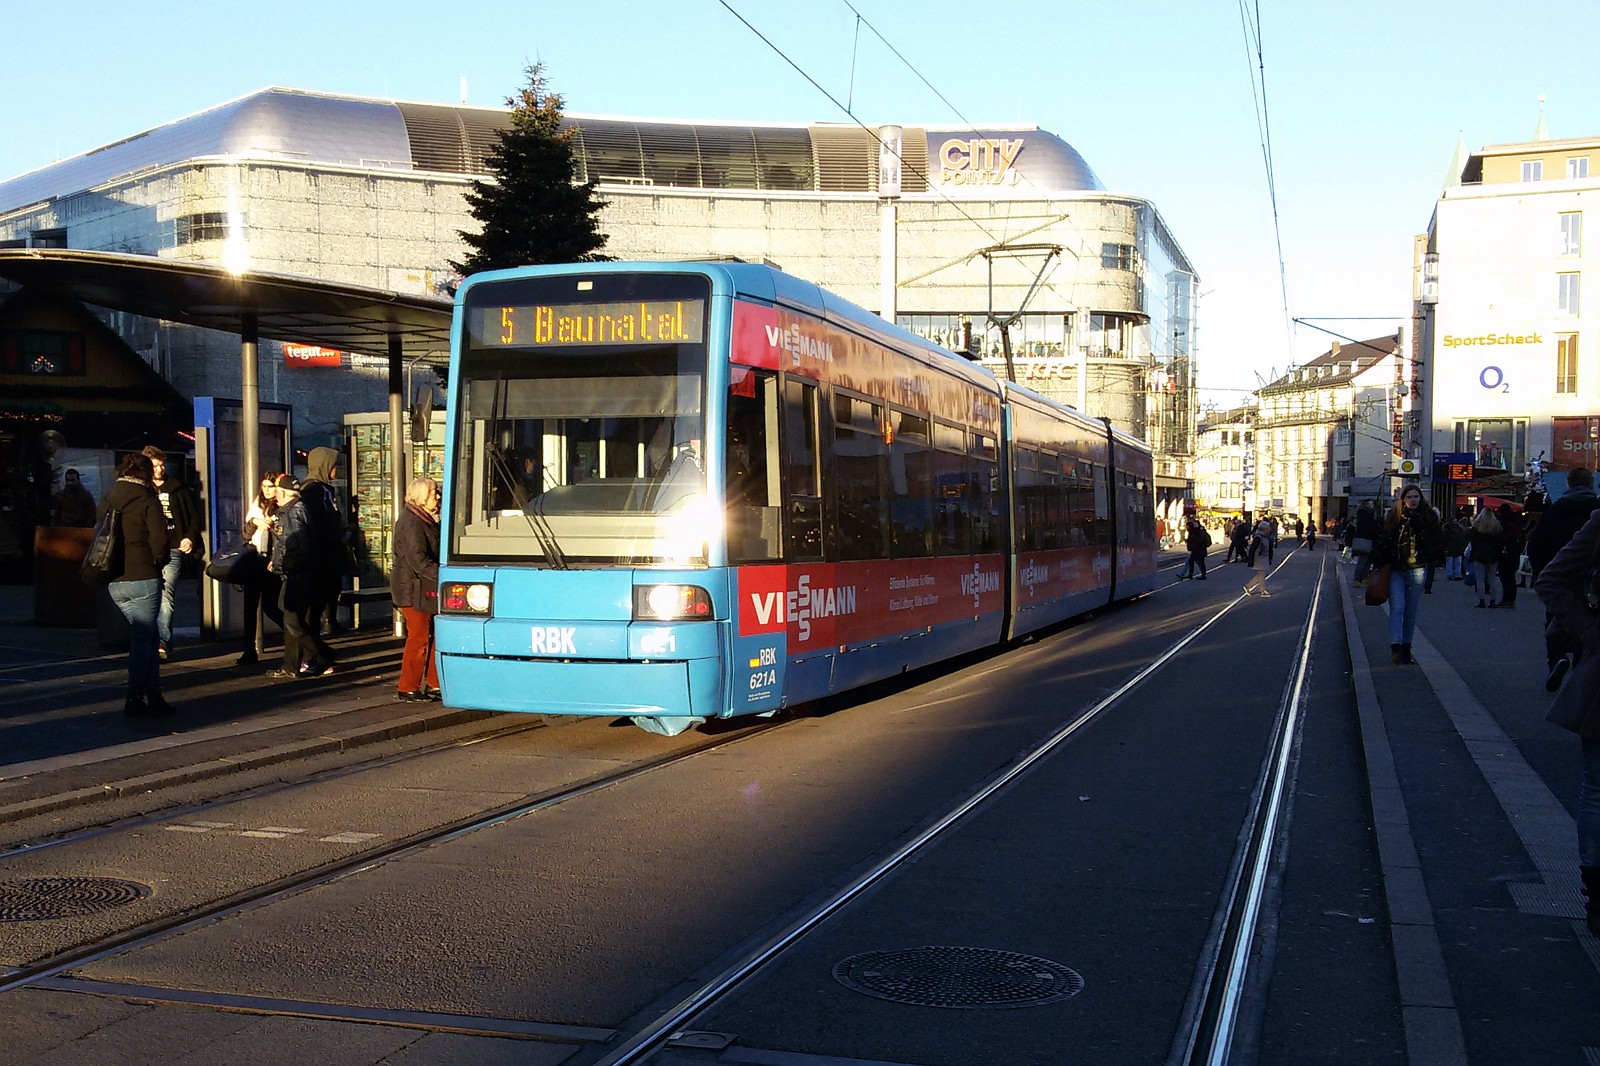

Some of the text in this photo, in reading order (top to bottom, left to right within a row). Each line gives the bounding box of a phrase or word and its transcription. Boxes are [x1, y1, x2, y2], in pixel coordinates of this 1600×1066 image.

[939, 138, 1024, 185] CITY
[941, 170, 993, 186] POINT
[500, 301, 689, 344] 5 Baunatal
[1443, 332, 1543, 348] SportScheck
[1026, 362, 1076, 381] KFC
[1562, 438, 1600, 453] Spor
[960, 562, 1000, 608] VIESSMANN
[751, 574, 857, 642] VIESSMANN
[531, 626, 577, 654] RBK
[760, 646, 777, 666] RBK
[749, 668, 776, 690] 621A
